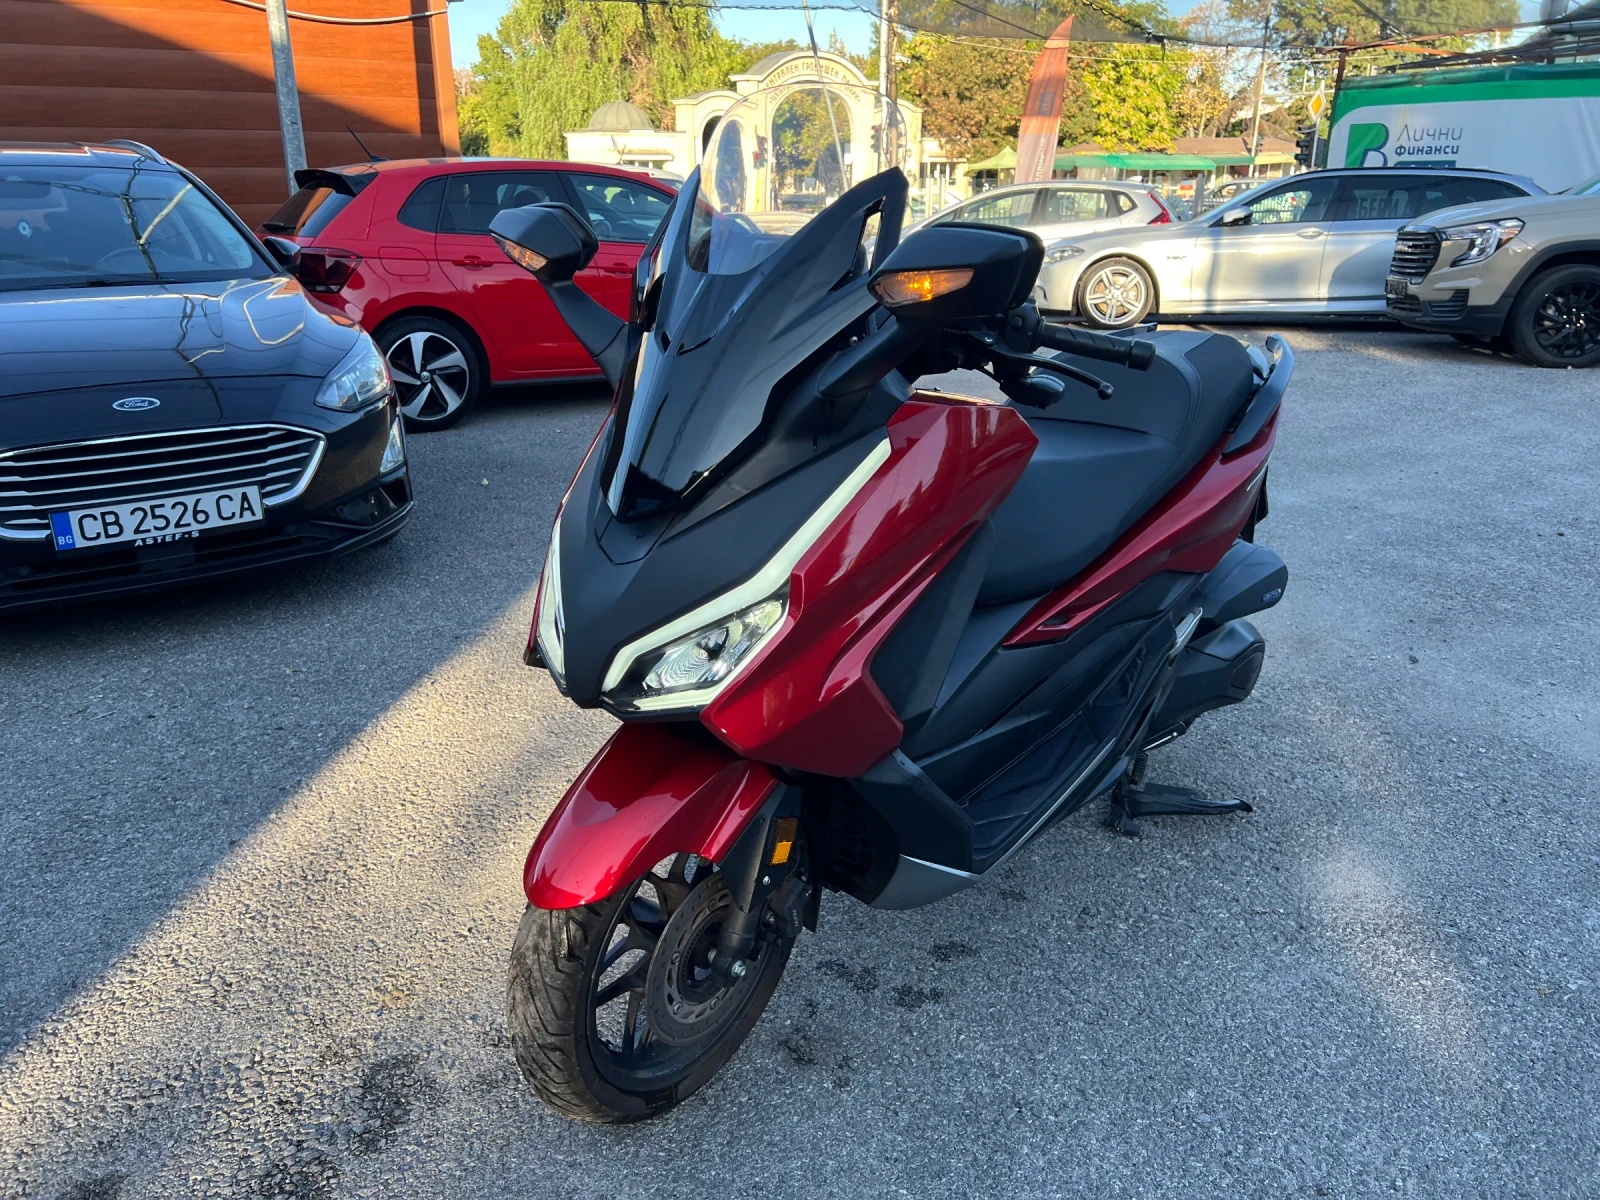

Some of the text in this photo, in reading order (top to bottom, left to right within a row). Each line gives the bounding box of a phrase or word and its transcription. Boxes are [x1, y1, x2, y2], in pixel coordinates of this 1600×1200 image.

[1396, 124, 1463, 141] Лични
[1394, 145, 1459, 157] финанси
[77, 492, 256, 541] CB 2526 CA
[57, 535, 74, 546] BG
[134, 530, 200, 547] ASTEF-S
